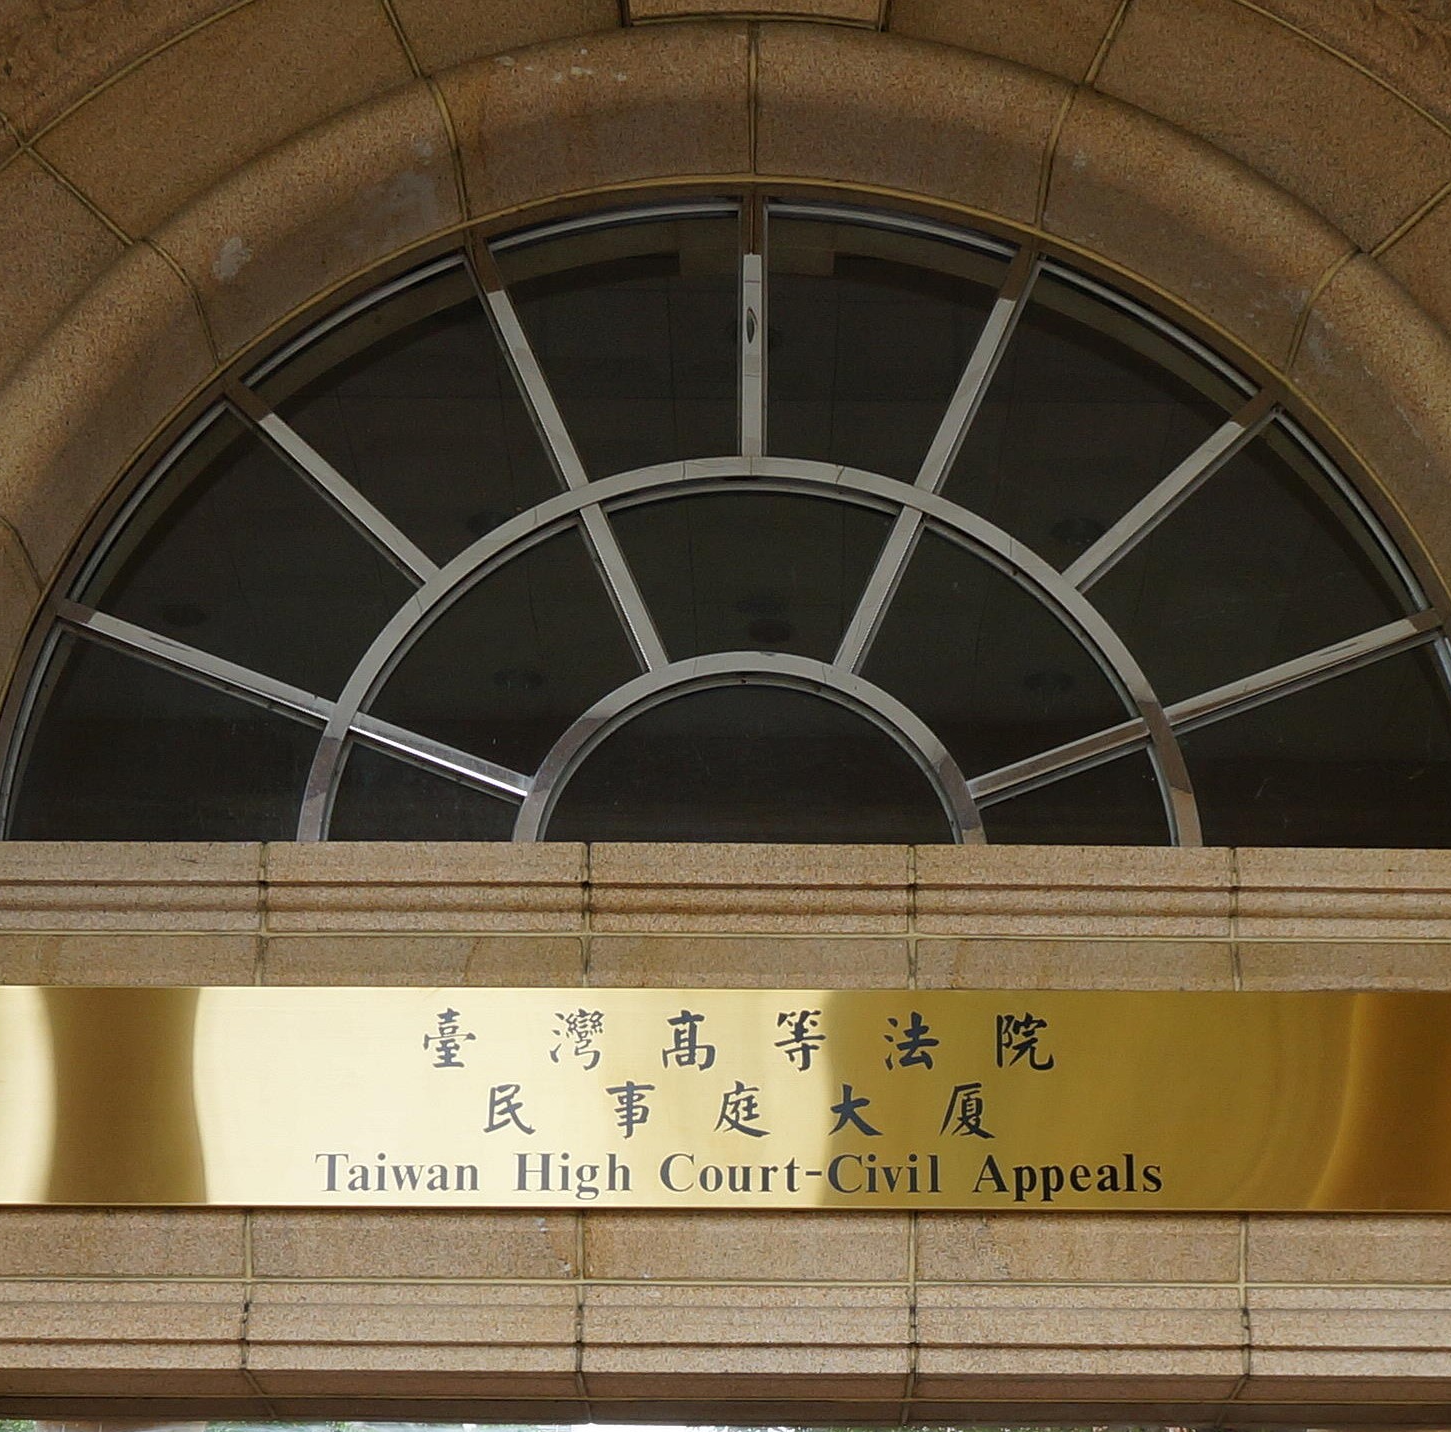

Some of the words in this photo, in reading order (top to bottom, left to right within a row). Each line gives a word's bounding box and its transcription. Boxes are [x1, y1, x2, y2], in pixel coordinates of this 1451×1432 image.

[423, 1007, 1054, 1072] 臺灣高等法院
[315, 1152, 481, 1193] Taiwan
[512, 1152, 633, 1201] High
[659, 1152, 942, 1195] Court-Civil
[972, 1152, 1163, 1202] Appeals
